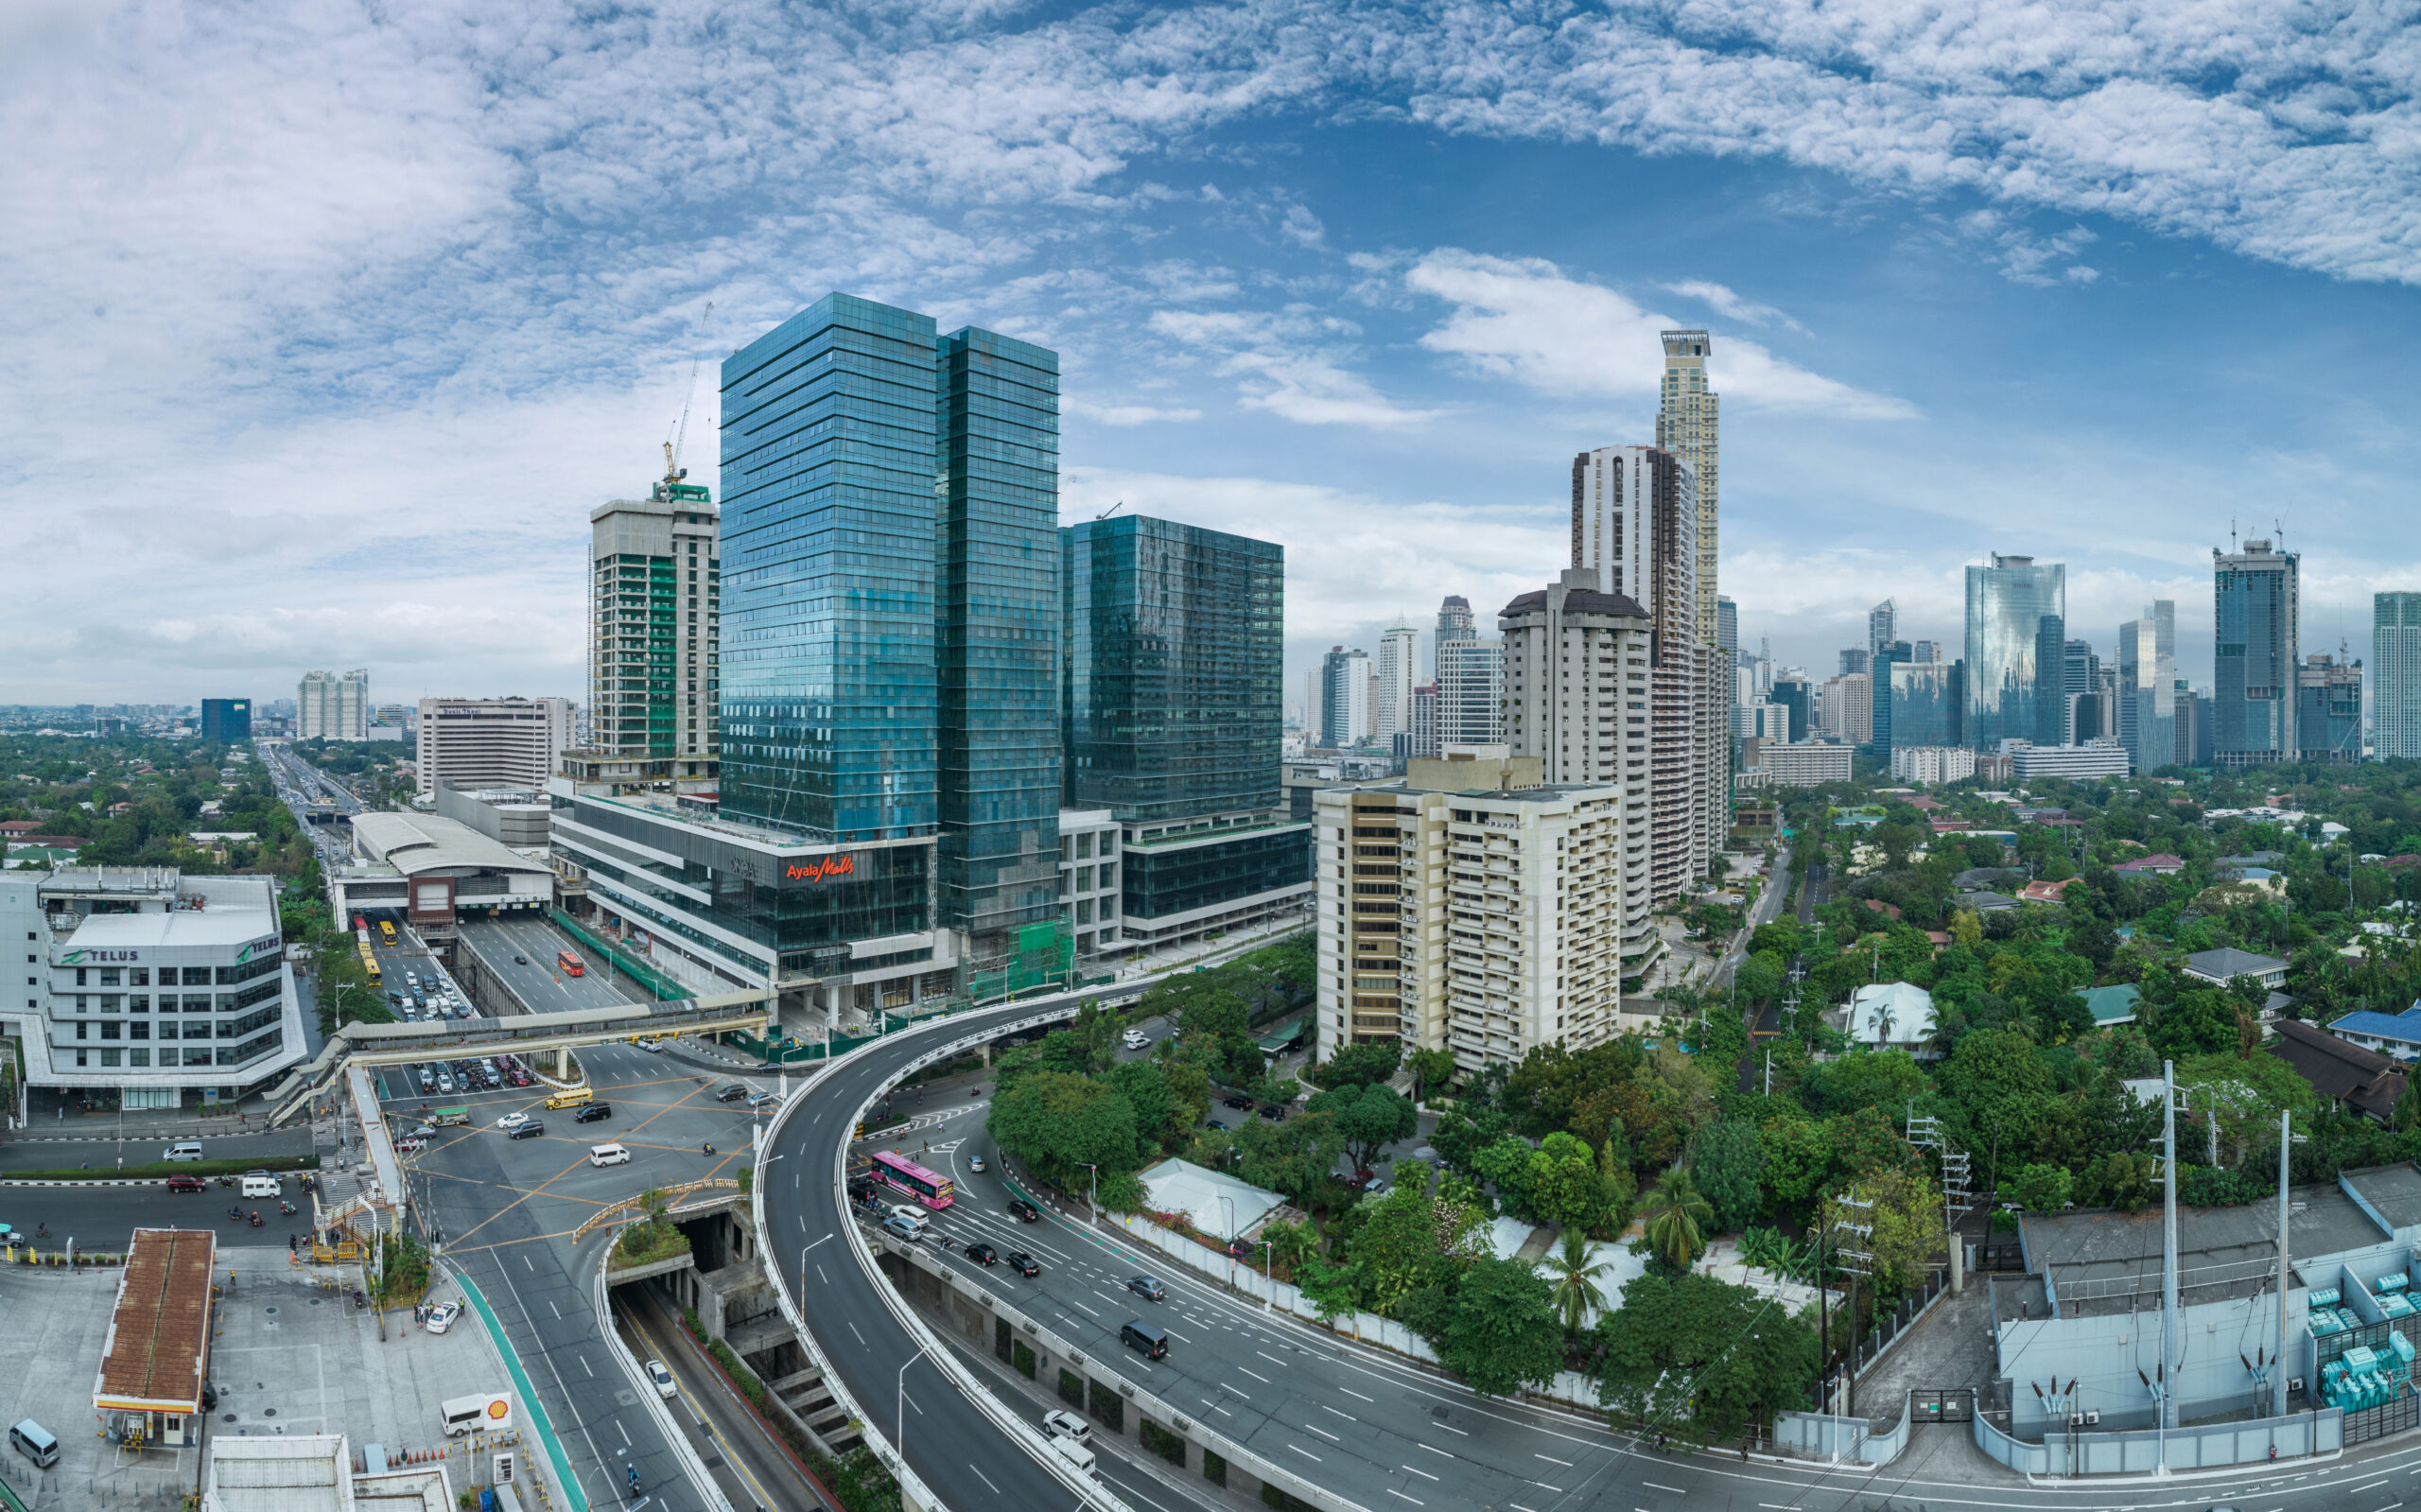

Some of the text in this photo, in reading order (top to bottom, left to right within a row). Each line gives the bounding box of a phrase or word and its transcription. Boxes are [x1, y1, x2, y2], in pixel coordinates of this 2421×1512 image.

[786, 855, 854, 883] Ayala Malls
[252, 936, 280, 953] TELUS
[90, 950, 139, 962] TELUS
